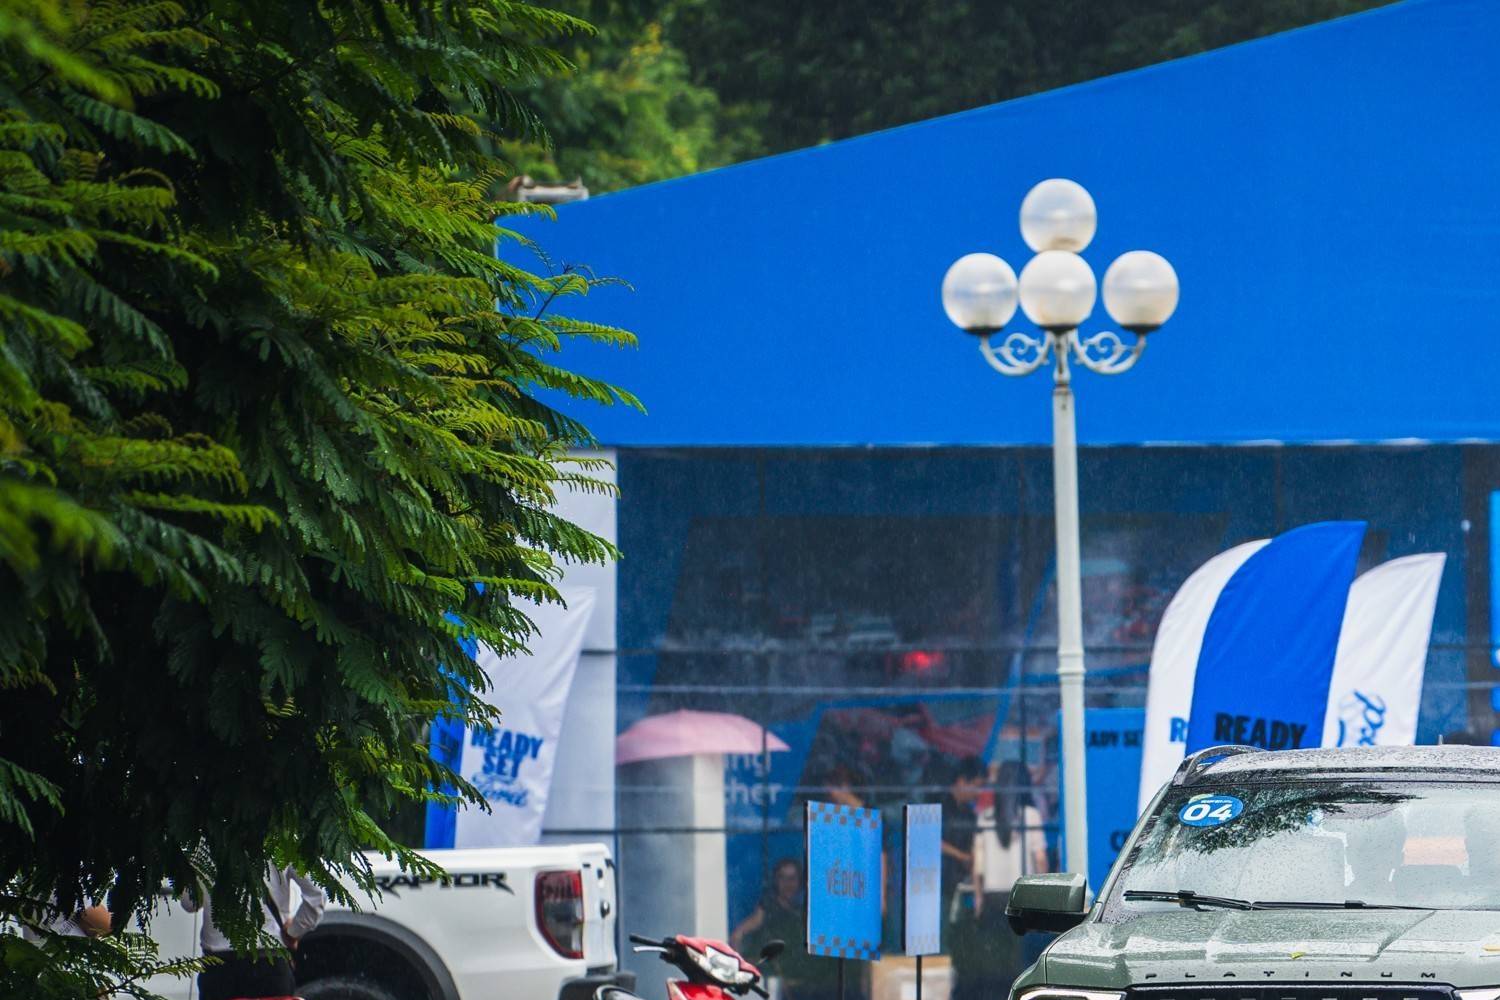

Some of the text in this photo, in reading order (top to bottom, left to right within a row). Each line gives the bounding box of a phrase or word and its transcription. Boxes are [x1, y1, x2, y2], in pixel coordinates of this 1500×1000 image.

[1213, 712, 1308, 750] READY
[1183, 803, 1234, 821] 04
[375, 871, 516, 900] RAPTOR
